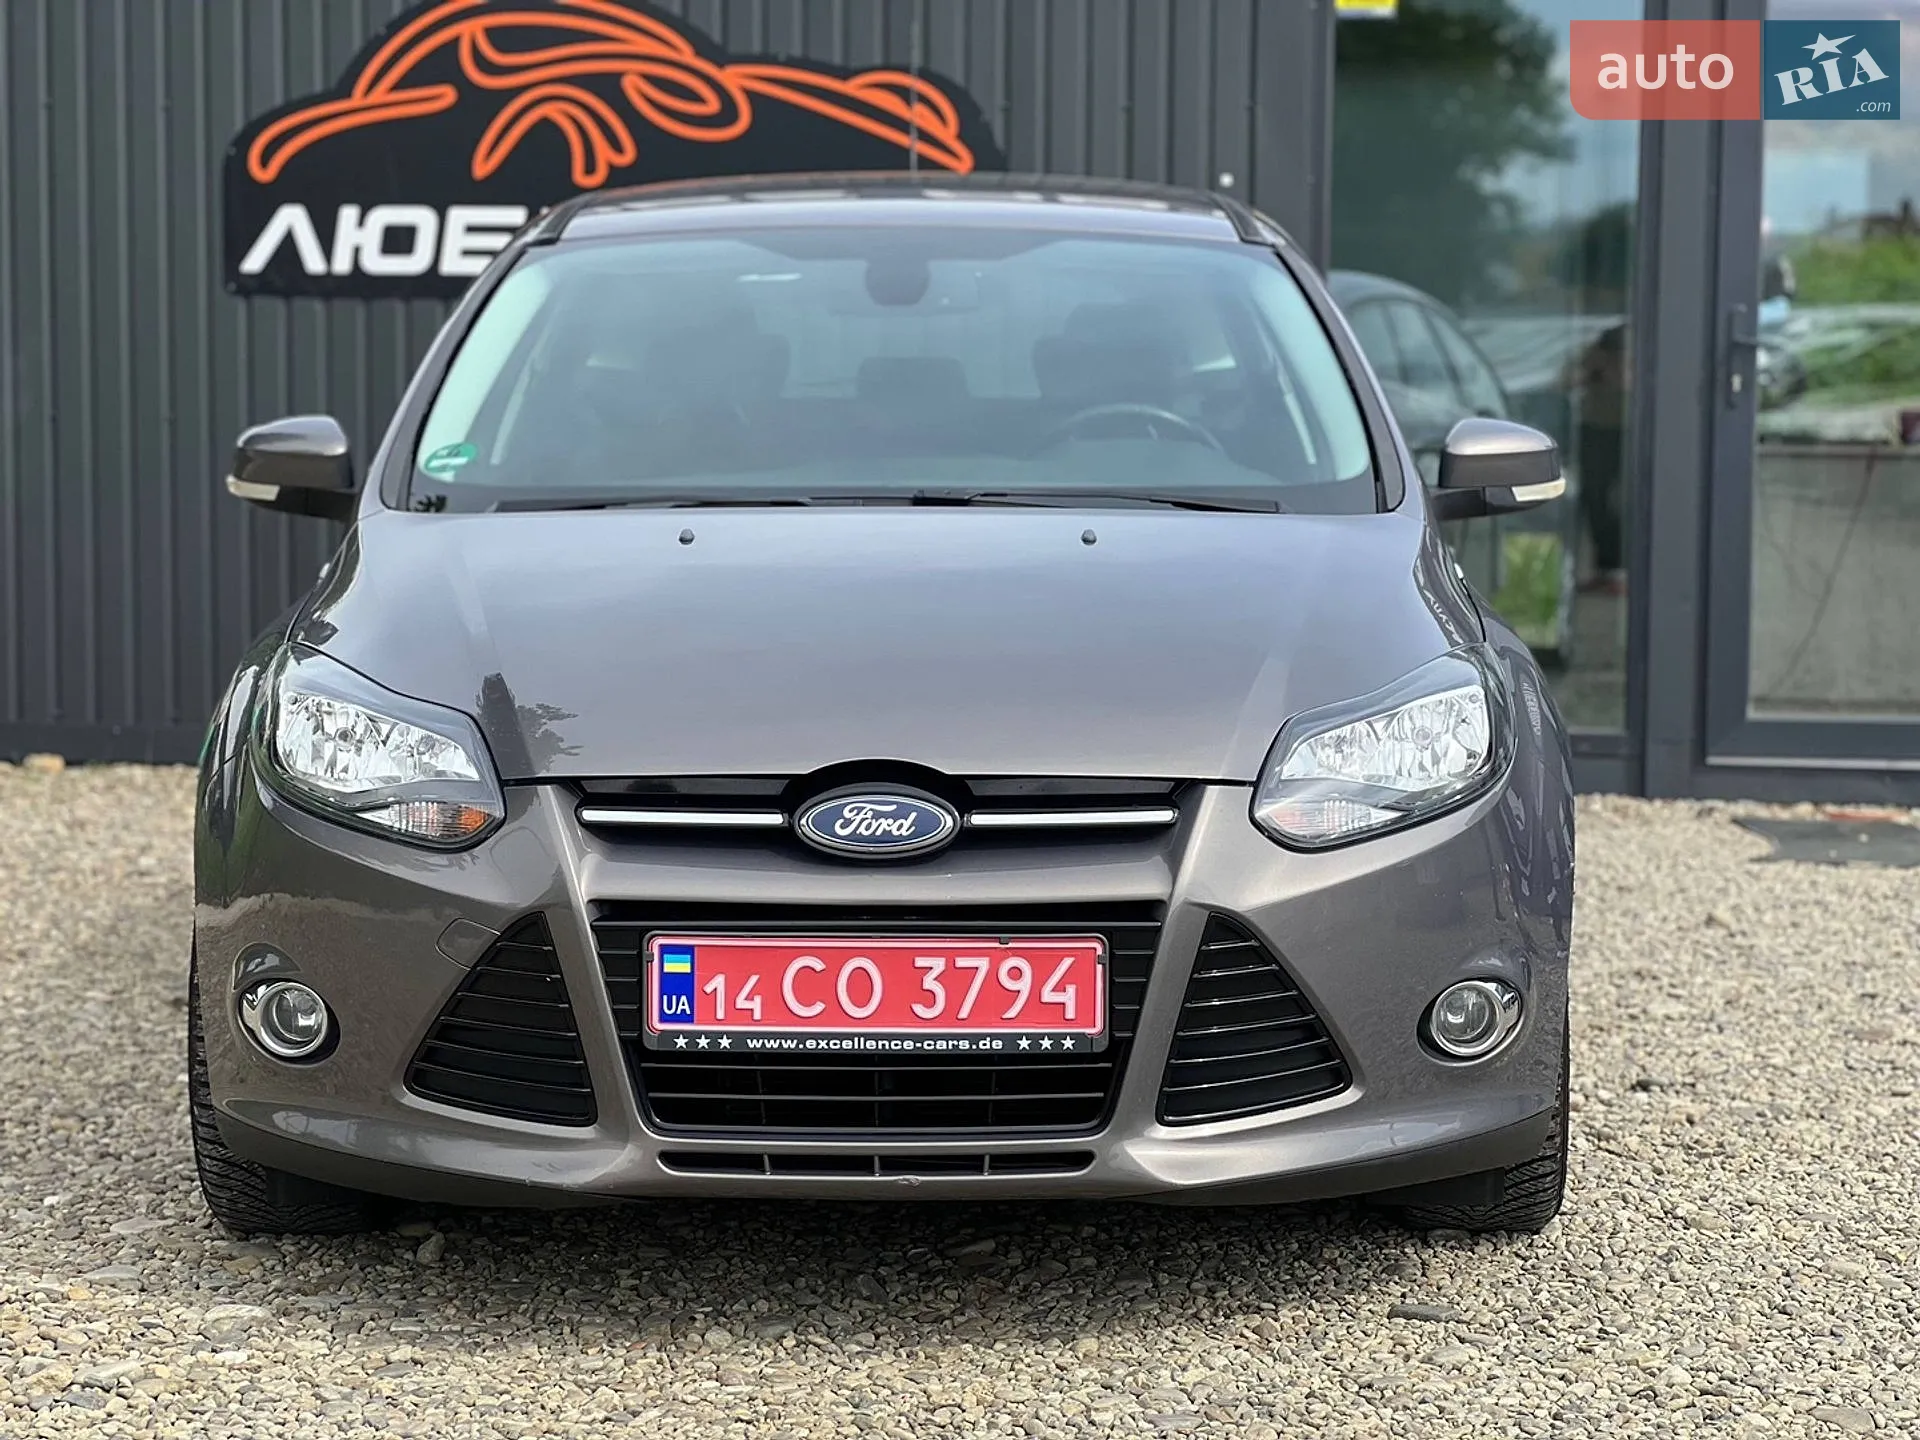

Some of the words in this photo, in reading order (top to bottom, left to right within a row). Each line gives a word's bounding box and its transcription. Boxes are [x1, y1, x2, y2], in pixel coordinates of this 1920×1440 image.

[834, 802, 918, 837] Ford
[702, 972, 763, 1021] 14
[781, 954, 884, 1019] CO
[910, 956, 1077, 1020] 3794
[662, 994, 692, 1015] UA
[746, 1035, 1003, 1050] www.excellence-cars.de
